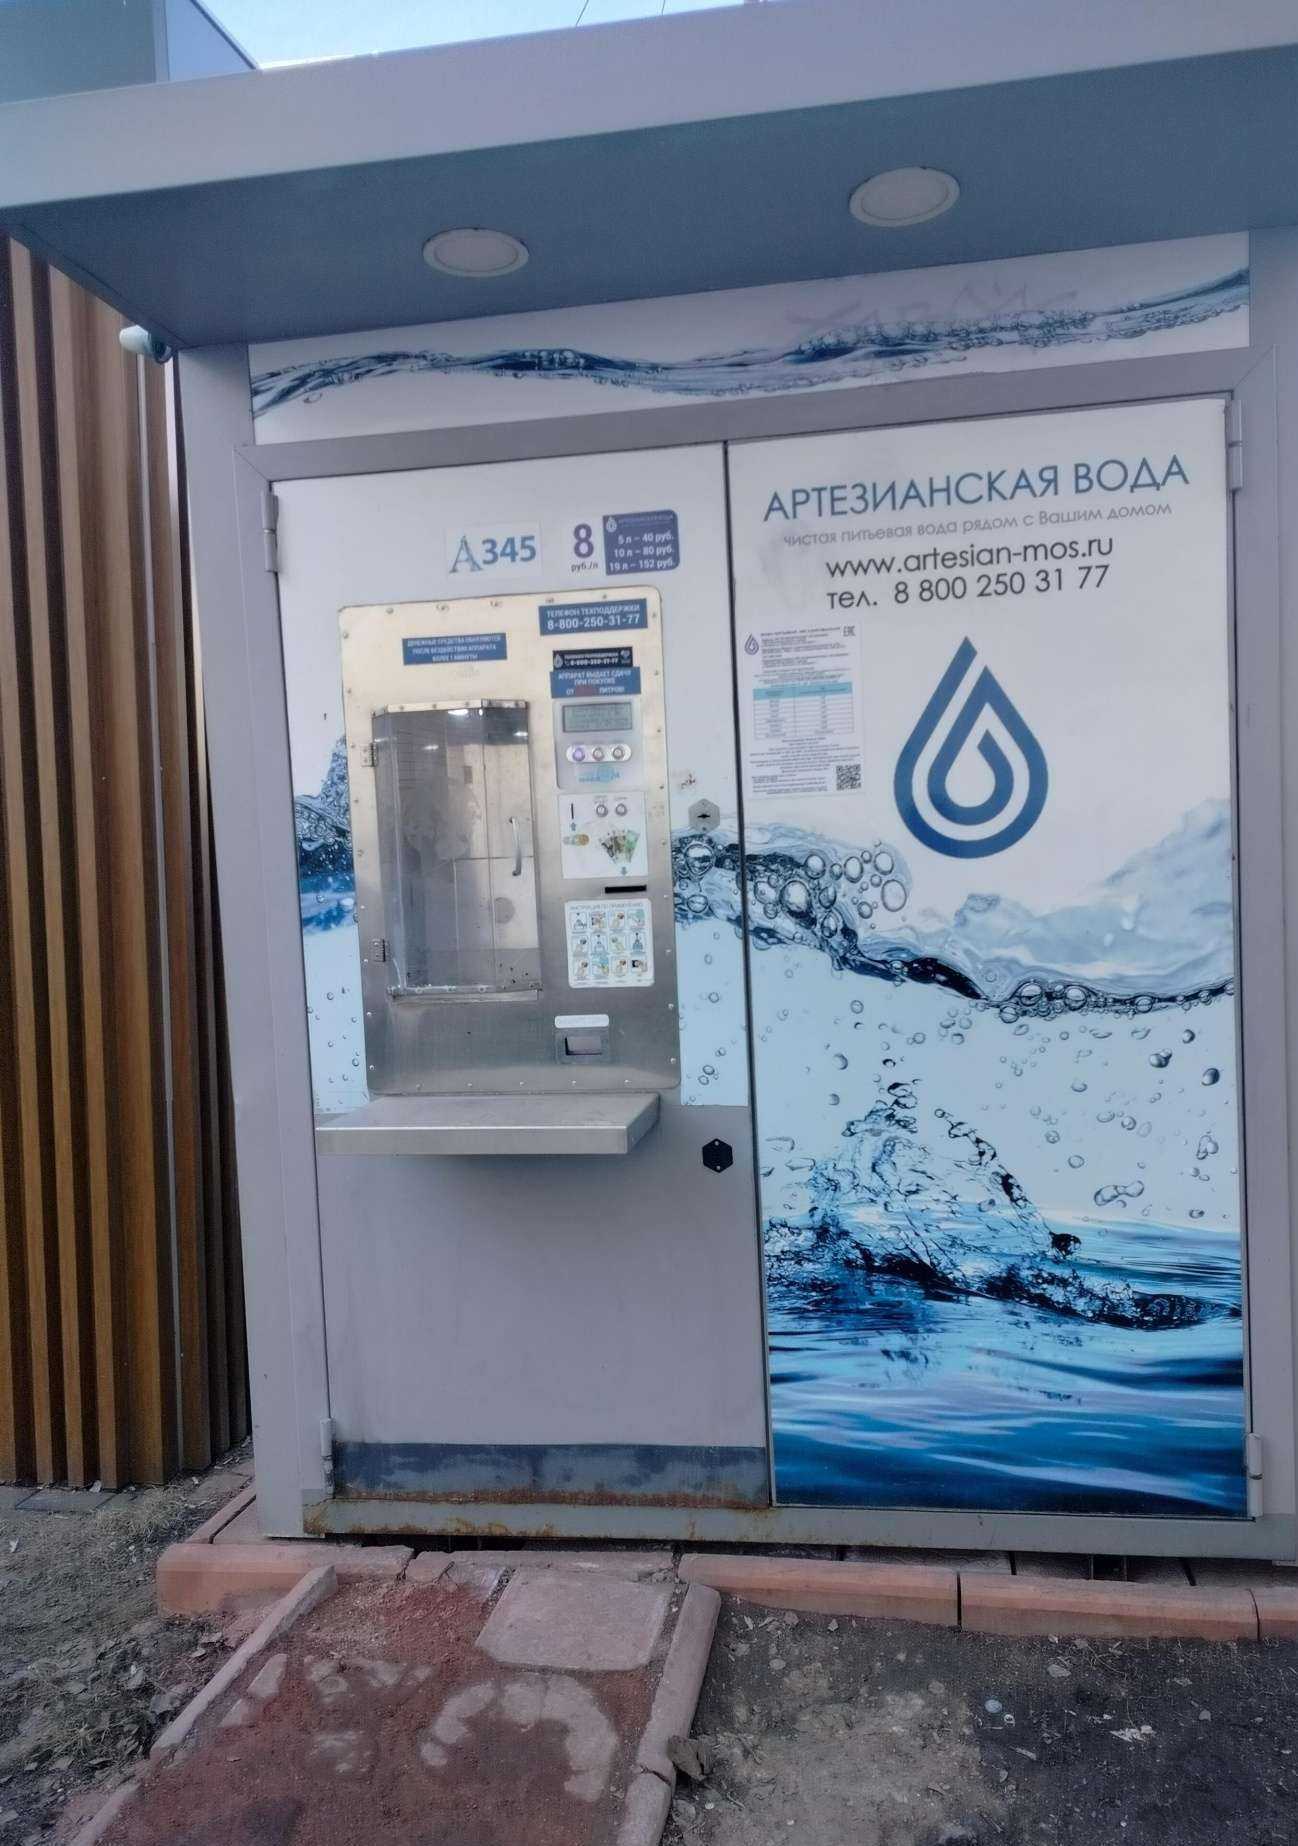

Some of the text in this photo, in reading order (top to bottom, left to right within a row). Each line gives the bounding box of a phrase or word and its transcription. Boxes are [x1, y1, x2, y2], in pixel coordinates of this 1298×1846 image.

[763, 454, 1190, 522] АРТЕЗИАНСКАЯ ВОДА
[573, 523, 594, 559] 8
[783, 502, 1173, 548] чистая питьевая вода рядом с Вашим домом
[609, 562, 620, 572] 19
[614, 548, 625, 558] 10
[825, 536, 1114, 578] www.artesian-mos.ru
[827, 564, 1110, 609] тел. 8 800 250 31 77
[546, 604, 640, 617] ТЕЛЕФОН ТЕХПОДДЕРЖКИ
[547, 614, 641, 630] 8-800-250-31-77
